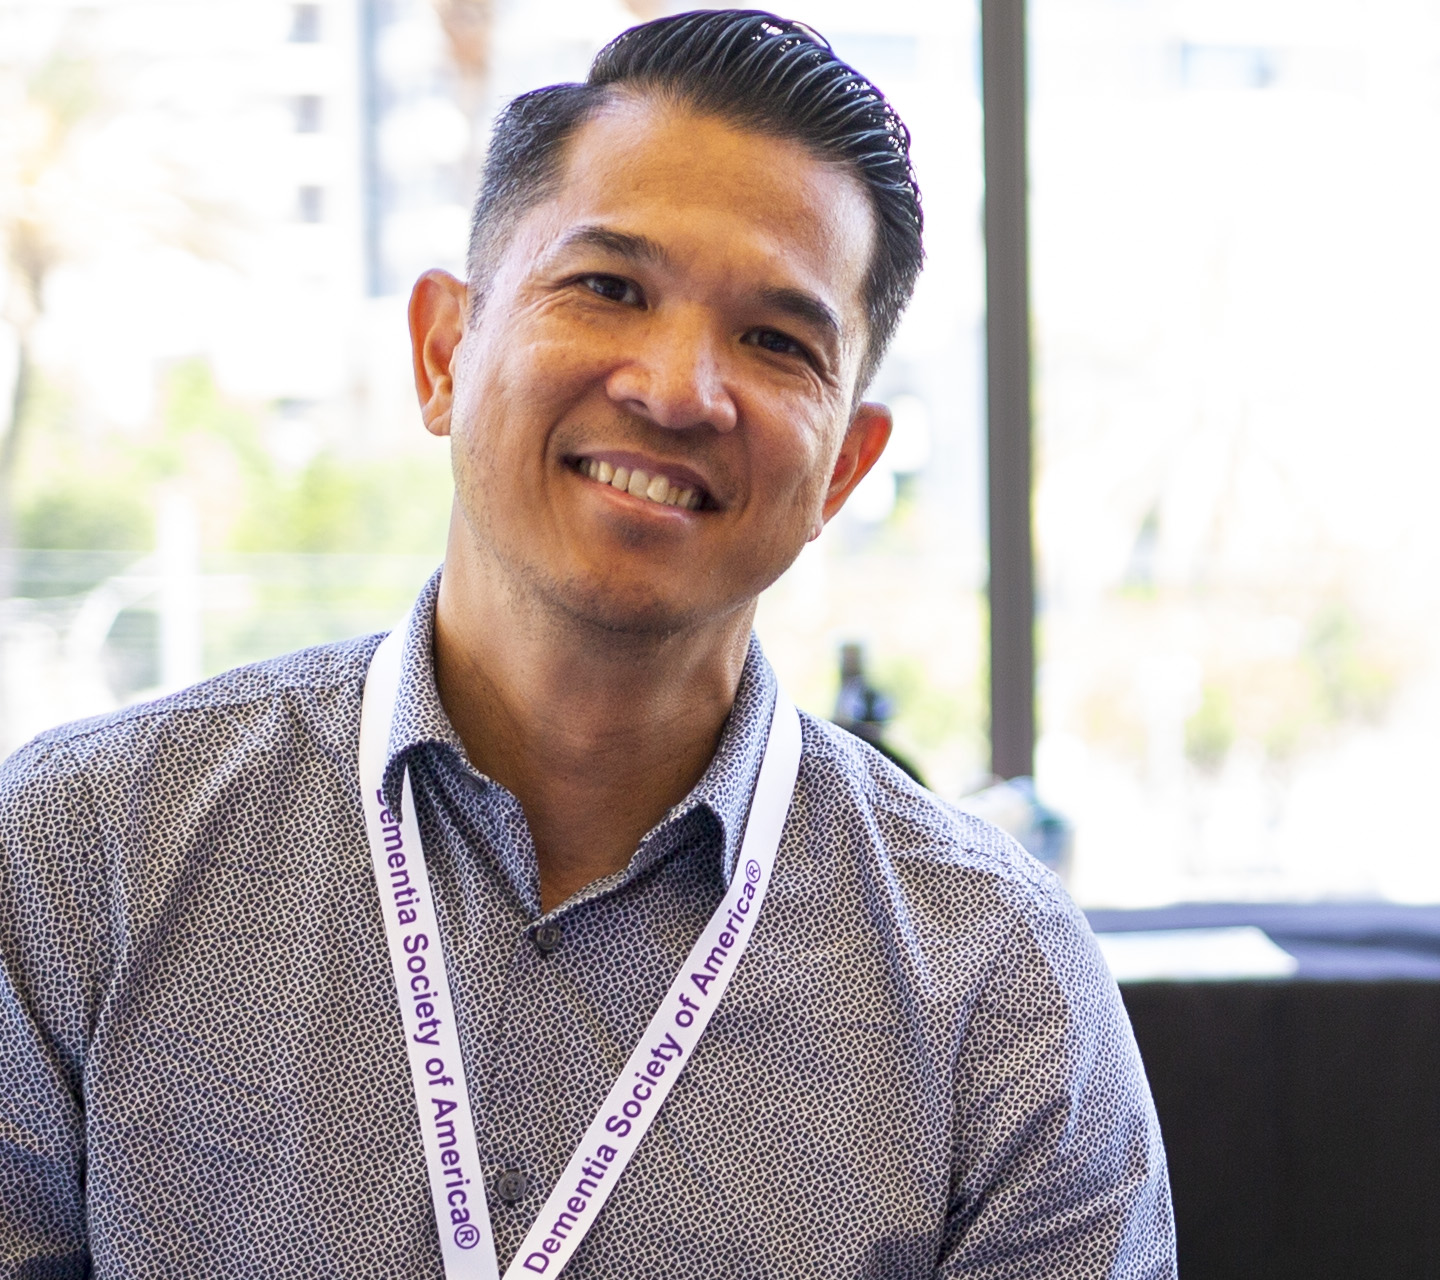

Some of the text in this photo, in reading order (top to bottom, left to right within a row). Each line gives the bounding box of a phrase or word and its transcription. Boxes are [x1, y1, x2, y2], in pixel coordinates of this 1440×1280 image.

[402, 932, 441, 1047] Society
[424, 1056, 454, 1089] of
[523, 1141, 617, 1275] Dementia
[604, 1029, 684, 1139] Society
[674, 993, 700, 1030] of
